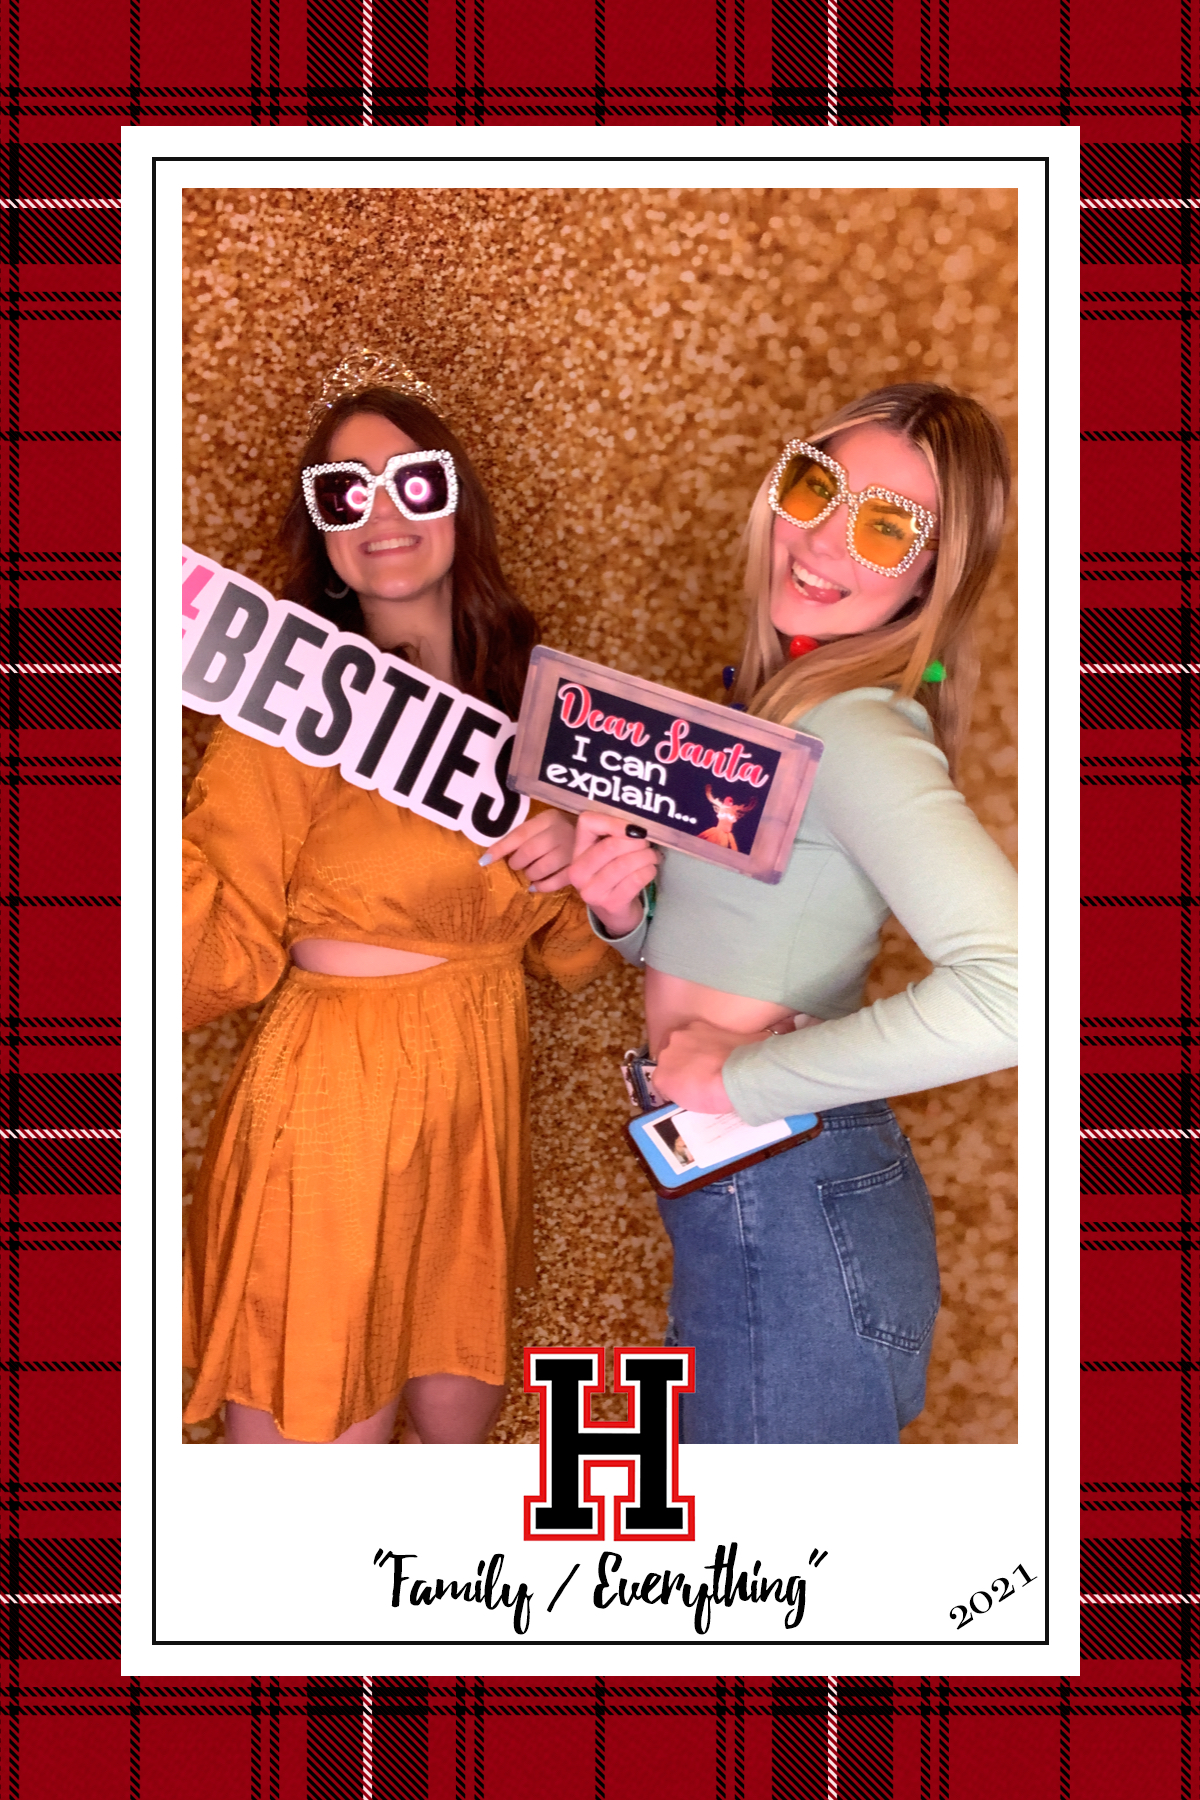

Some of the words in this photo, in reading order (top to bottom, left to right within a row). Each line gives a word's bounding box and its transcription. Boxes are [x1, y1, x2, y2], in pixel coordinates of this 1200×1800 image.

[558, 683, 650, 747] Dear
[654, 719, 769, 788] Santa
[572, 735, 591, 762] I
[600, 750, 668, 786] can
[546, 763, 698, 825] explain...
